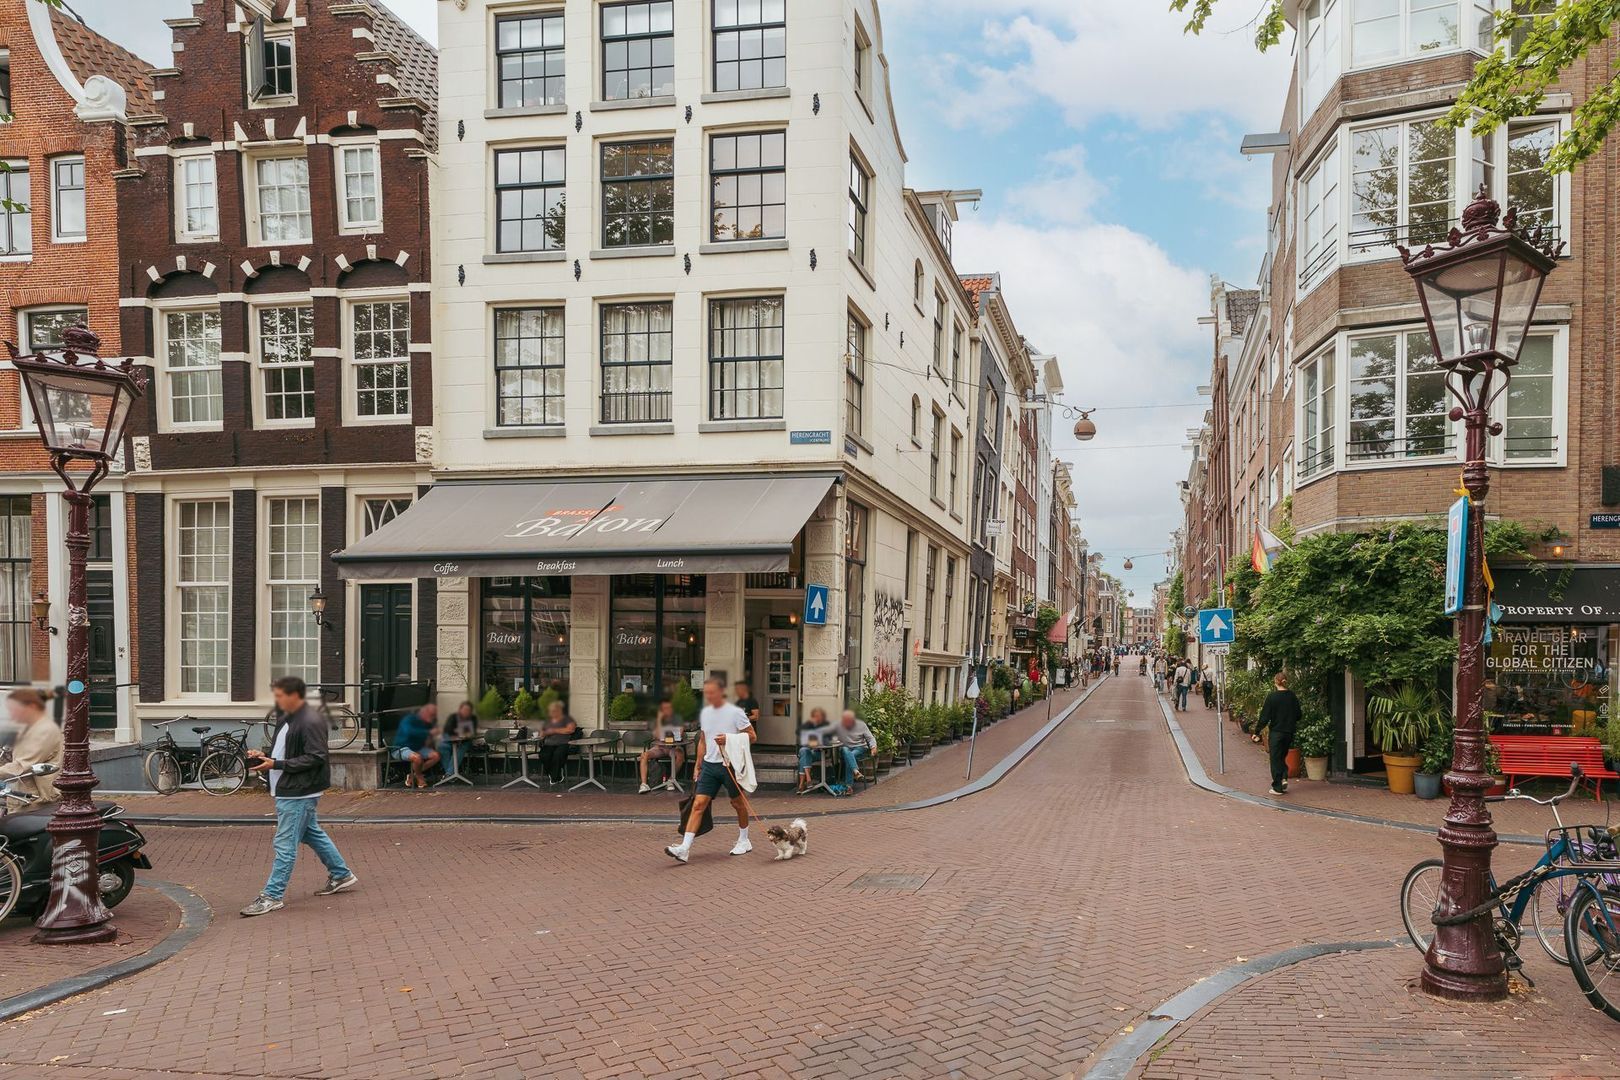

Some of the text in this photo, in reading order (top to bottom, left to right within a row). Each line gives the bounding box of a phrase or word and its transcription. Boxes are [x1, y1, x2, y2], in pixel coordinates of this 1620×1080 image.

[537, 561, 576, 573] Breakfast
[657, 558, 684, 568] Lunch
[433, 563, 459, 575] Coffee
[1552, 632, 1588, 643] GEAR
[1512, 644, 1569, 656] FOR THE
[1486, 657, 1594, 668] GLOBAL CITIZEN
